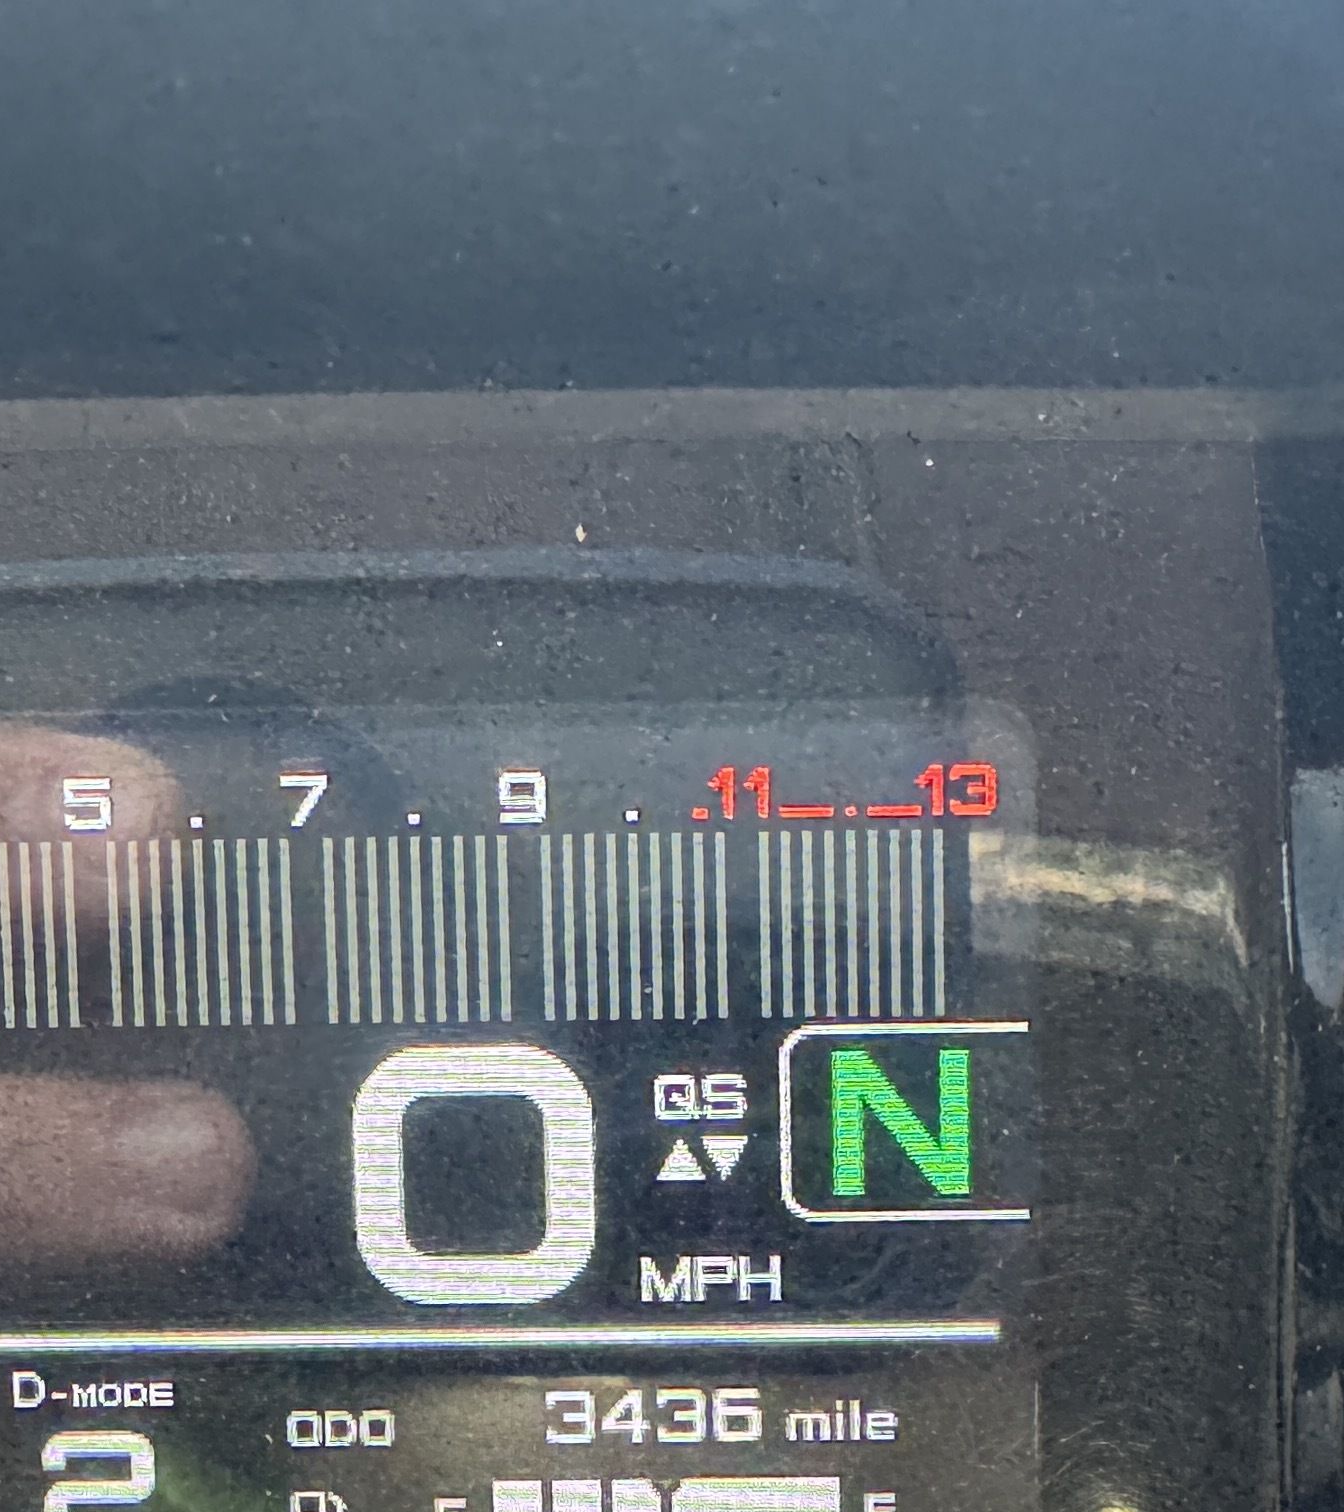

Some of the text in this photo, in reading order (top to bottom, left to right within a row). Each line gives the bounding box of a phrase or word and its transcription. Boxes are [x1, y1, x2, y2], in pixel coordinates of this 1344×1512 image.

[63, 776, 111, 829] 5
[279, 770, 329, 827] 7
[499, 769, 547, 824] 9
[707, 765, 771, 819] 11
[914, 763, 998, 816] 13
[654, 1074, 748, 1120] QS
[831, 1049, 970, 1196] N
[352, 1044, 594, 1305] 0
[639, 1255, 783, 1303] MPH
[12, 1371, 175, 1408] D-MODE
[545, 1387, 899, 1443] 3436 mile
[287, 1409, 396, 1447] ODO
